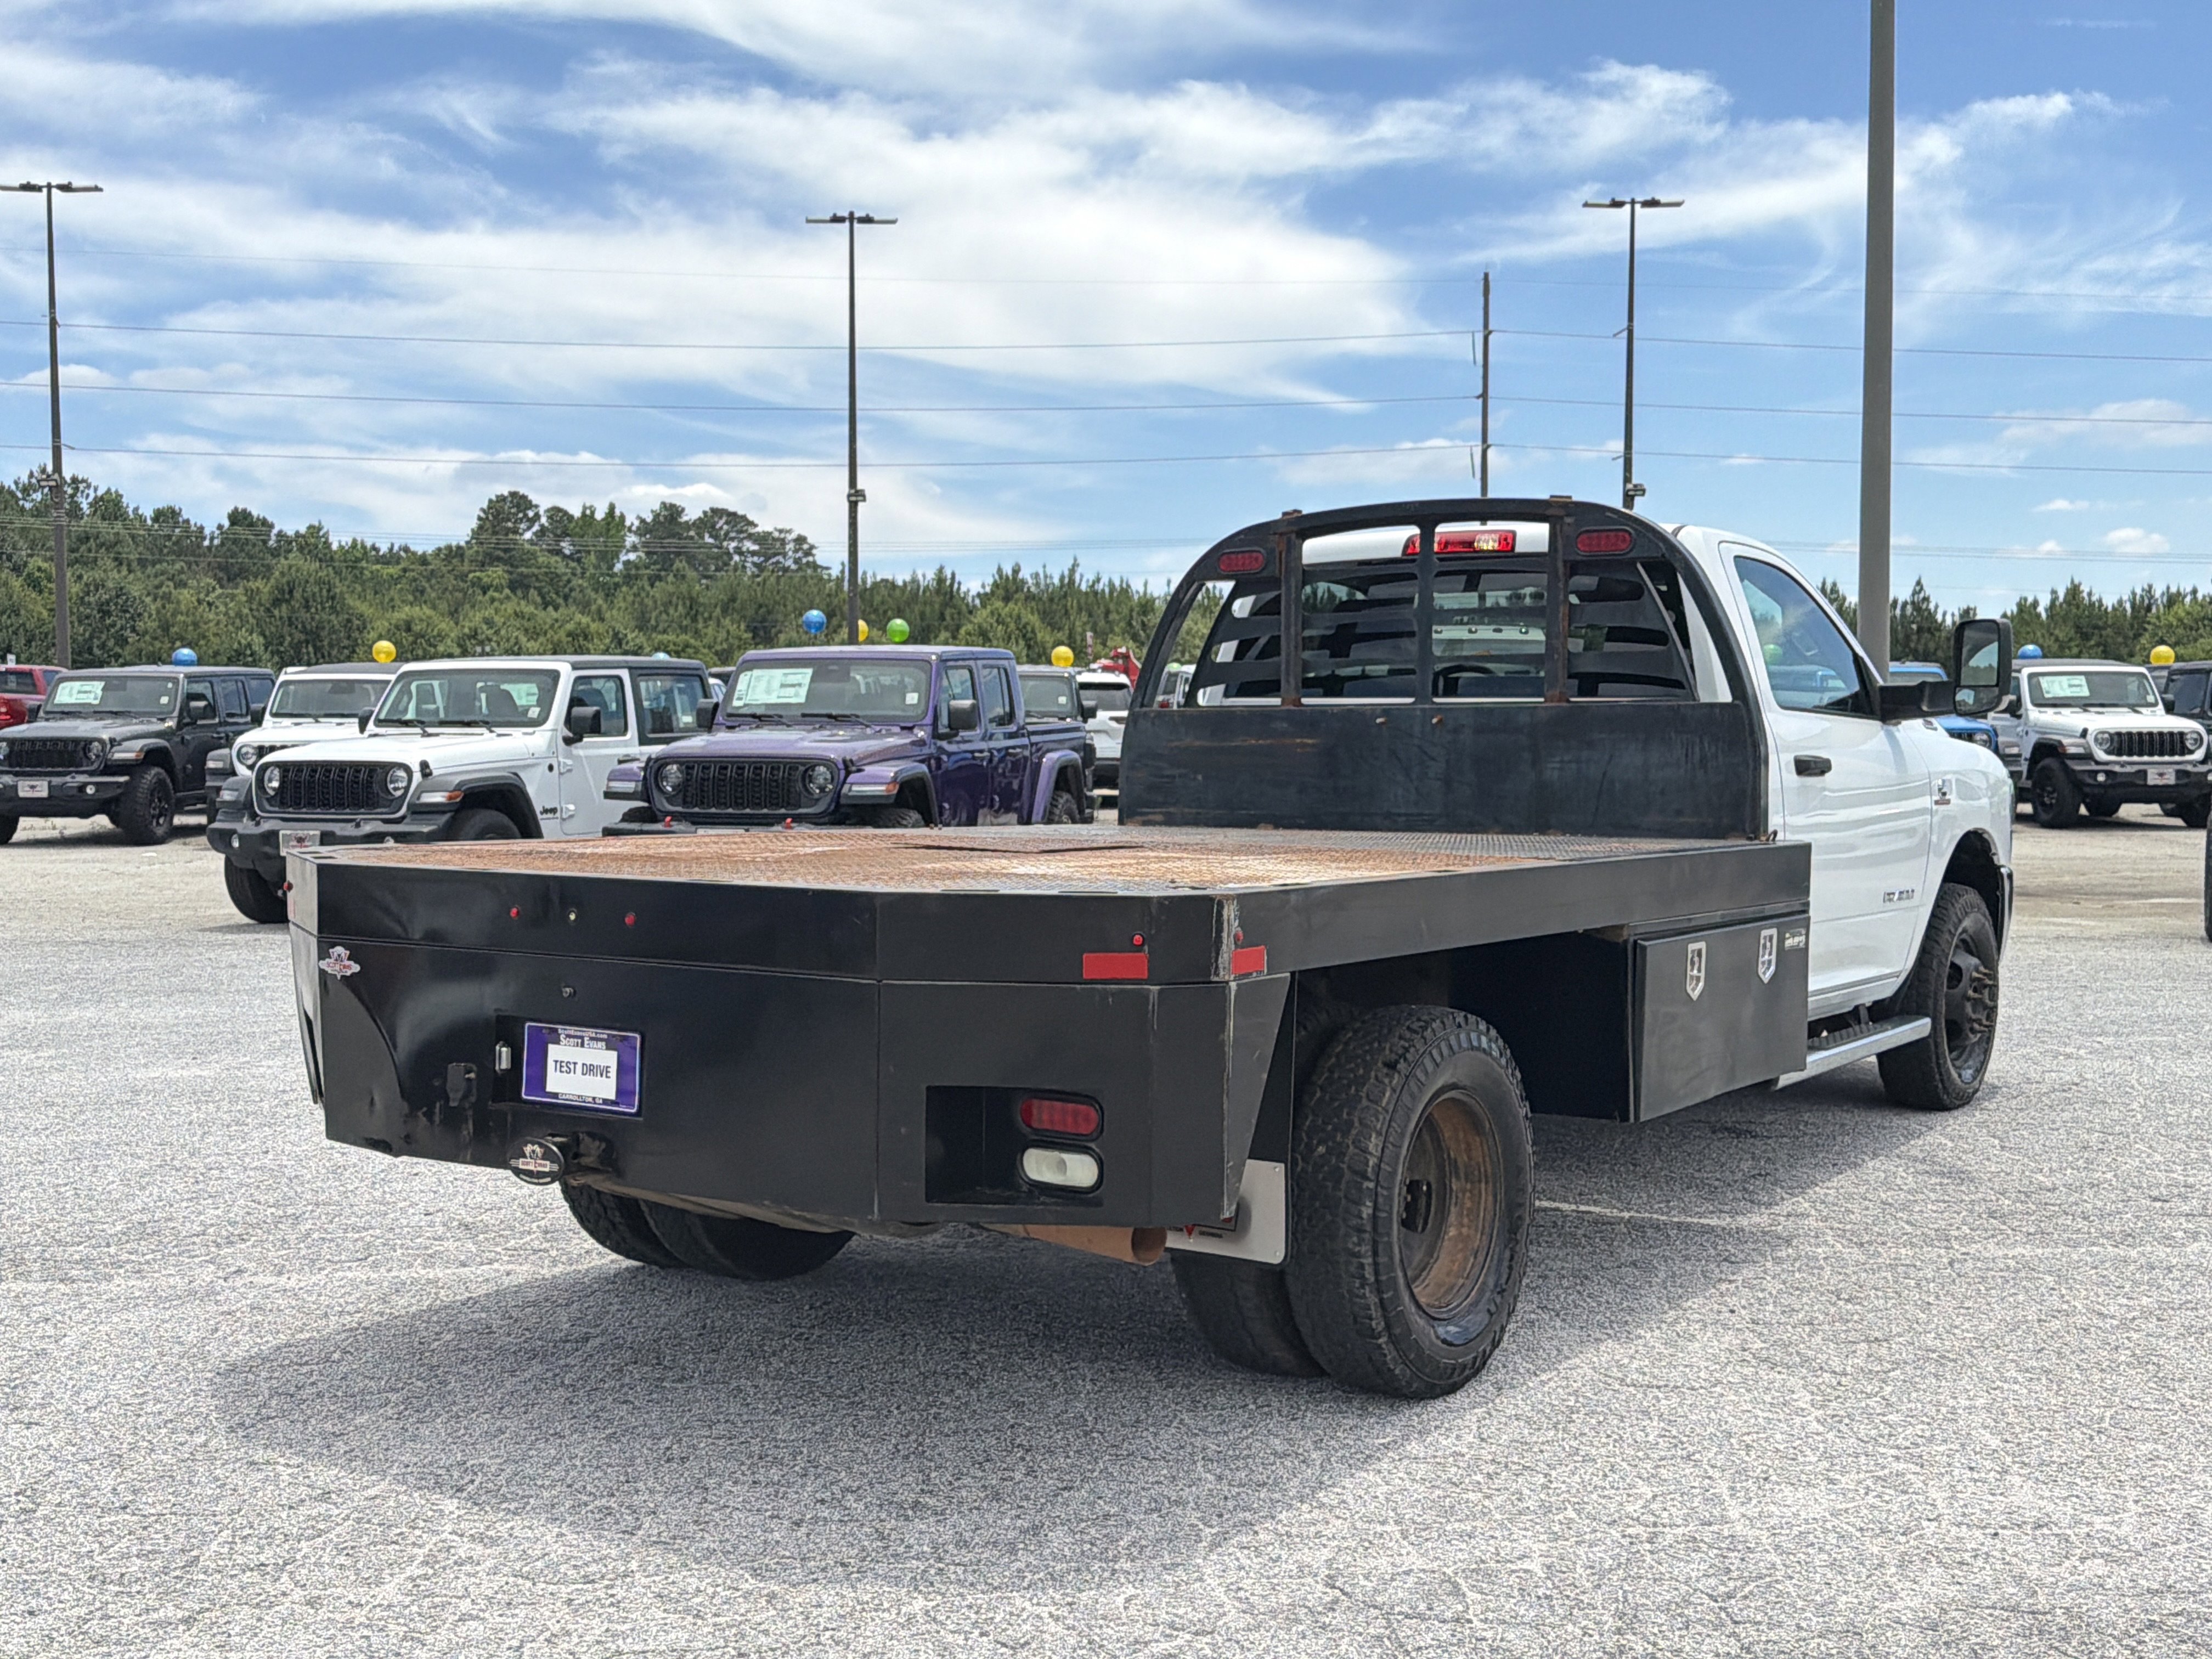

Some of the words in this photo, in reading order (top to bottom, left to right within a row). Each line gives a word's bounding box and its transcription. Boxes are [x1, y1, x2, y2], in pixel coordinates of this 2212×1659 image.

[539, 805, 558, 816] Jeep
[560, 1034, 582, 1047] SCOTT
[584, 1036, 606, 1049] EVANS
[552, 1059, 578, 1075] TEST
[581, 1062, 611, 1079] DRIVE
